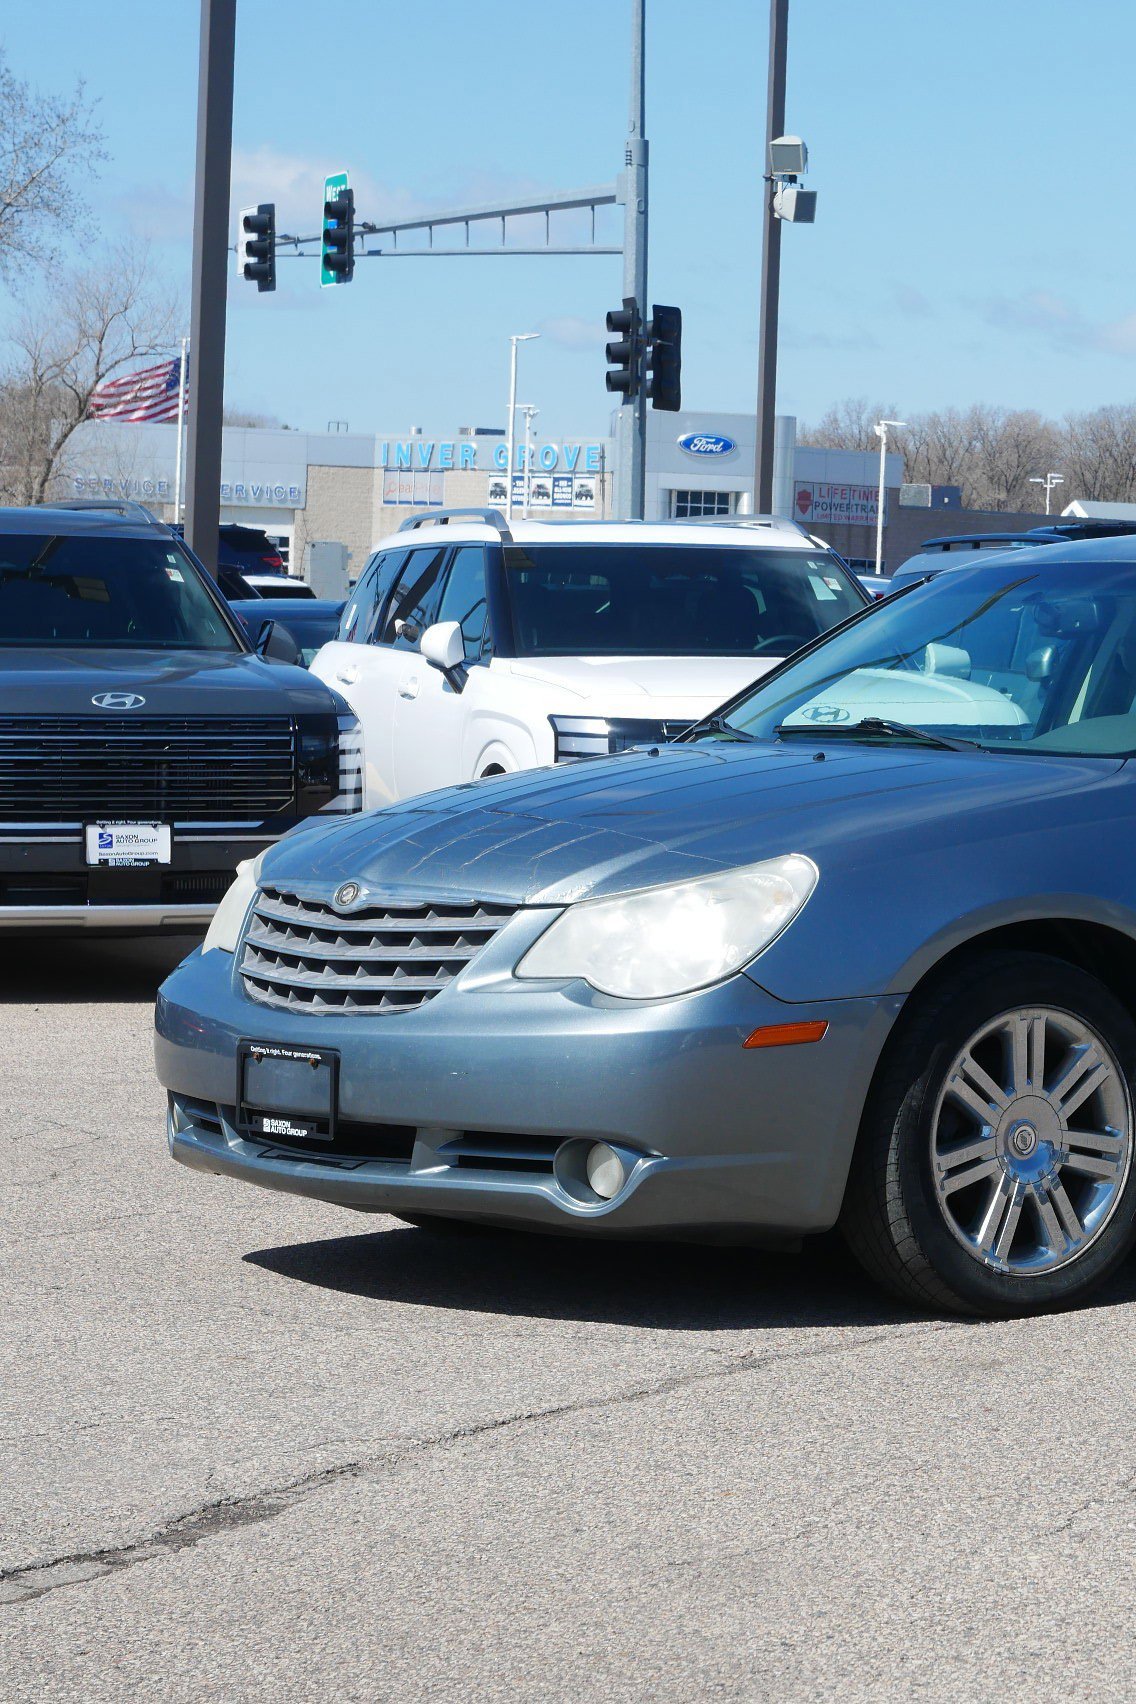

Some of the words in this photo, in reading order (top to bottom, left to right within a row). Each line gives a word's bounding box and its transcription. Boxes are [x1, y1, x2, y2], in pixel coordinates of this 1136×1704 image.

[690, 436, 724, 452] Ford
[381, 442, 477, 469] INVER
[493, 442, 600, 471] GROVE
[74, 476, 168, 495] SERVICE
[220, 482, 300, 500] ERVICE
[818, 487, 880, 502] LIFETIME
[814, 501, 885, 515] POWERTRAI
[281, 1049, 293, 1057] Four
[271, 1119, 291, 1128] SAXON
[271, 1125, 287, 1134] AUTO
[287, 1128, 308, 1136] GROUP
